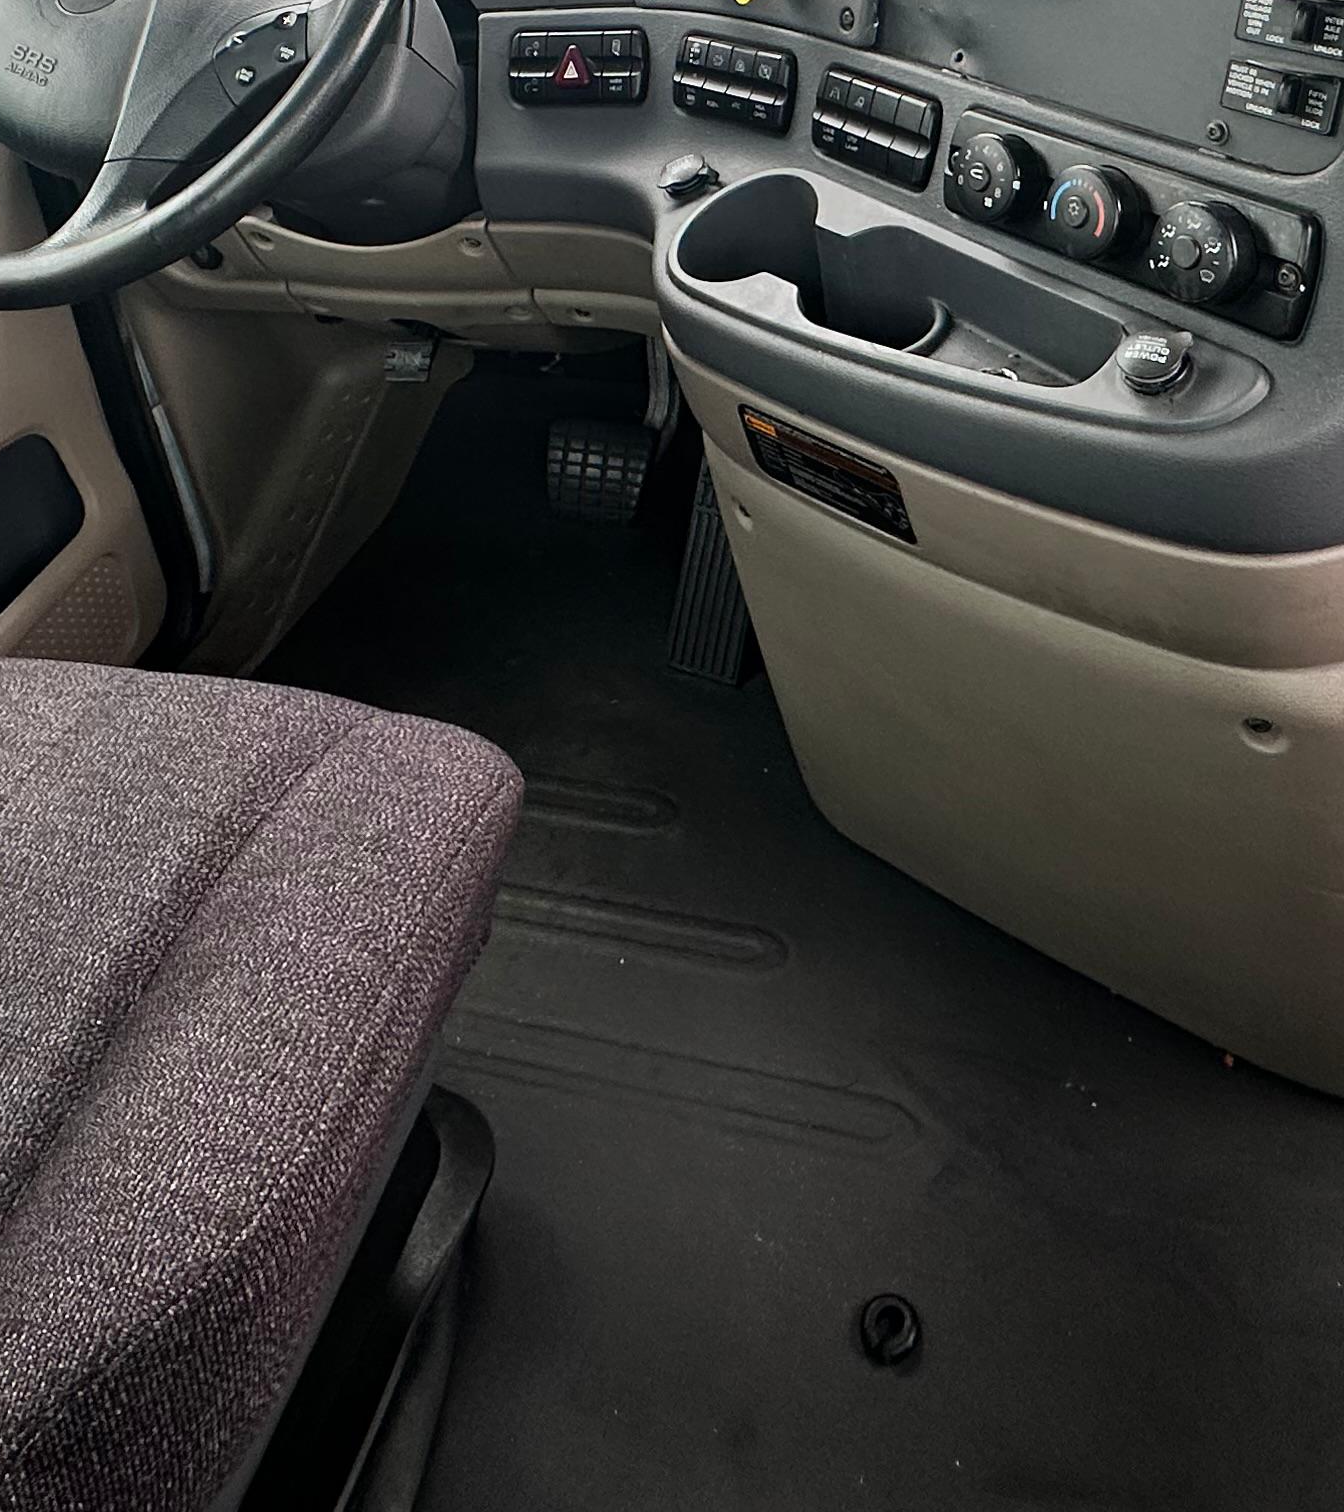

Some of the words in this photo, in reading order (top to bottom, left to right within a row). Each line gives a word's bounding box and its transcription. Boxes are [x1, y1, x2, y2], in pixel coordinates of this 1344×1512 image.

[1265, 33, 1285, 44] LOCK
[1313, 43, 1344, 58] UNLOCK
[10, 43, 58, 75] SRS
[1245, 102, 1273, 116] UNLOCK
[1301, 119, 1321, 131] LOCK
[965, 148, 972, 161] 2
[997, 161, 1004, 172] 6
[957, 174, 964, 186] 0
[994, 186, 1002, 199] 8
[1127, 343, 1171, 356] OUTLET
[1124, 350, 1168, 365] POWER
